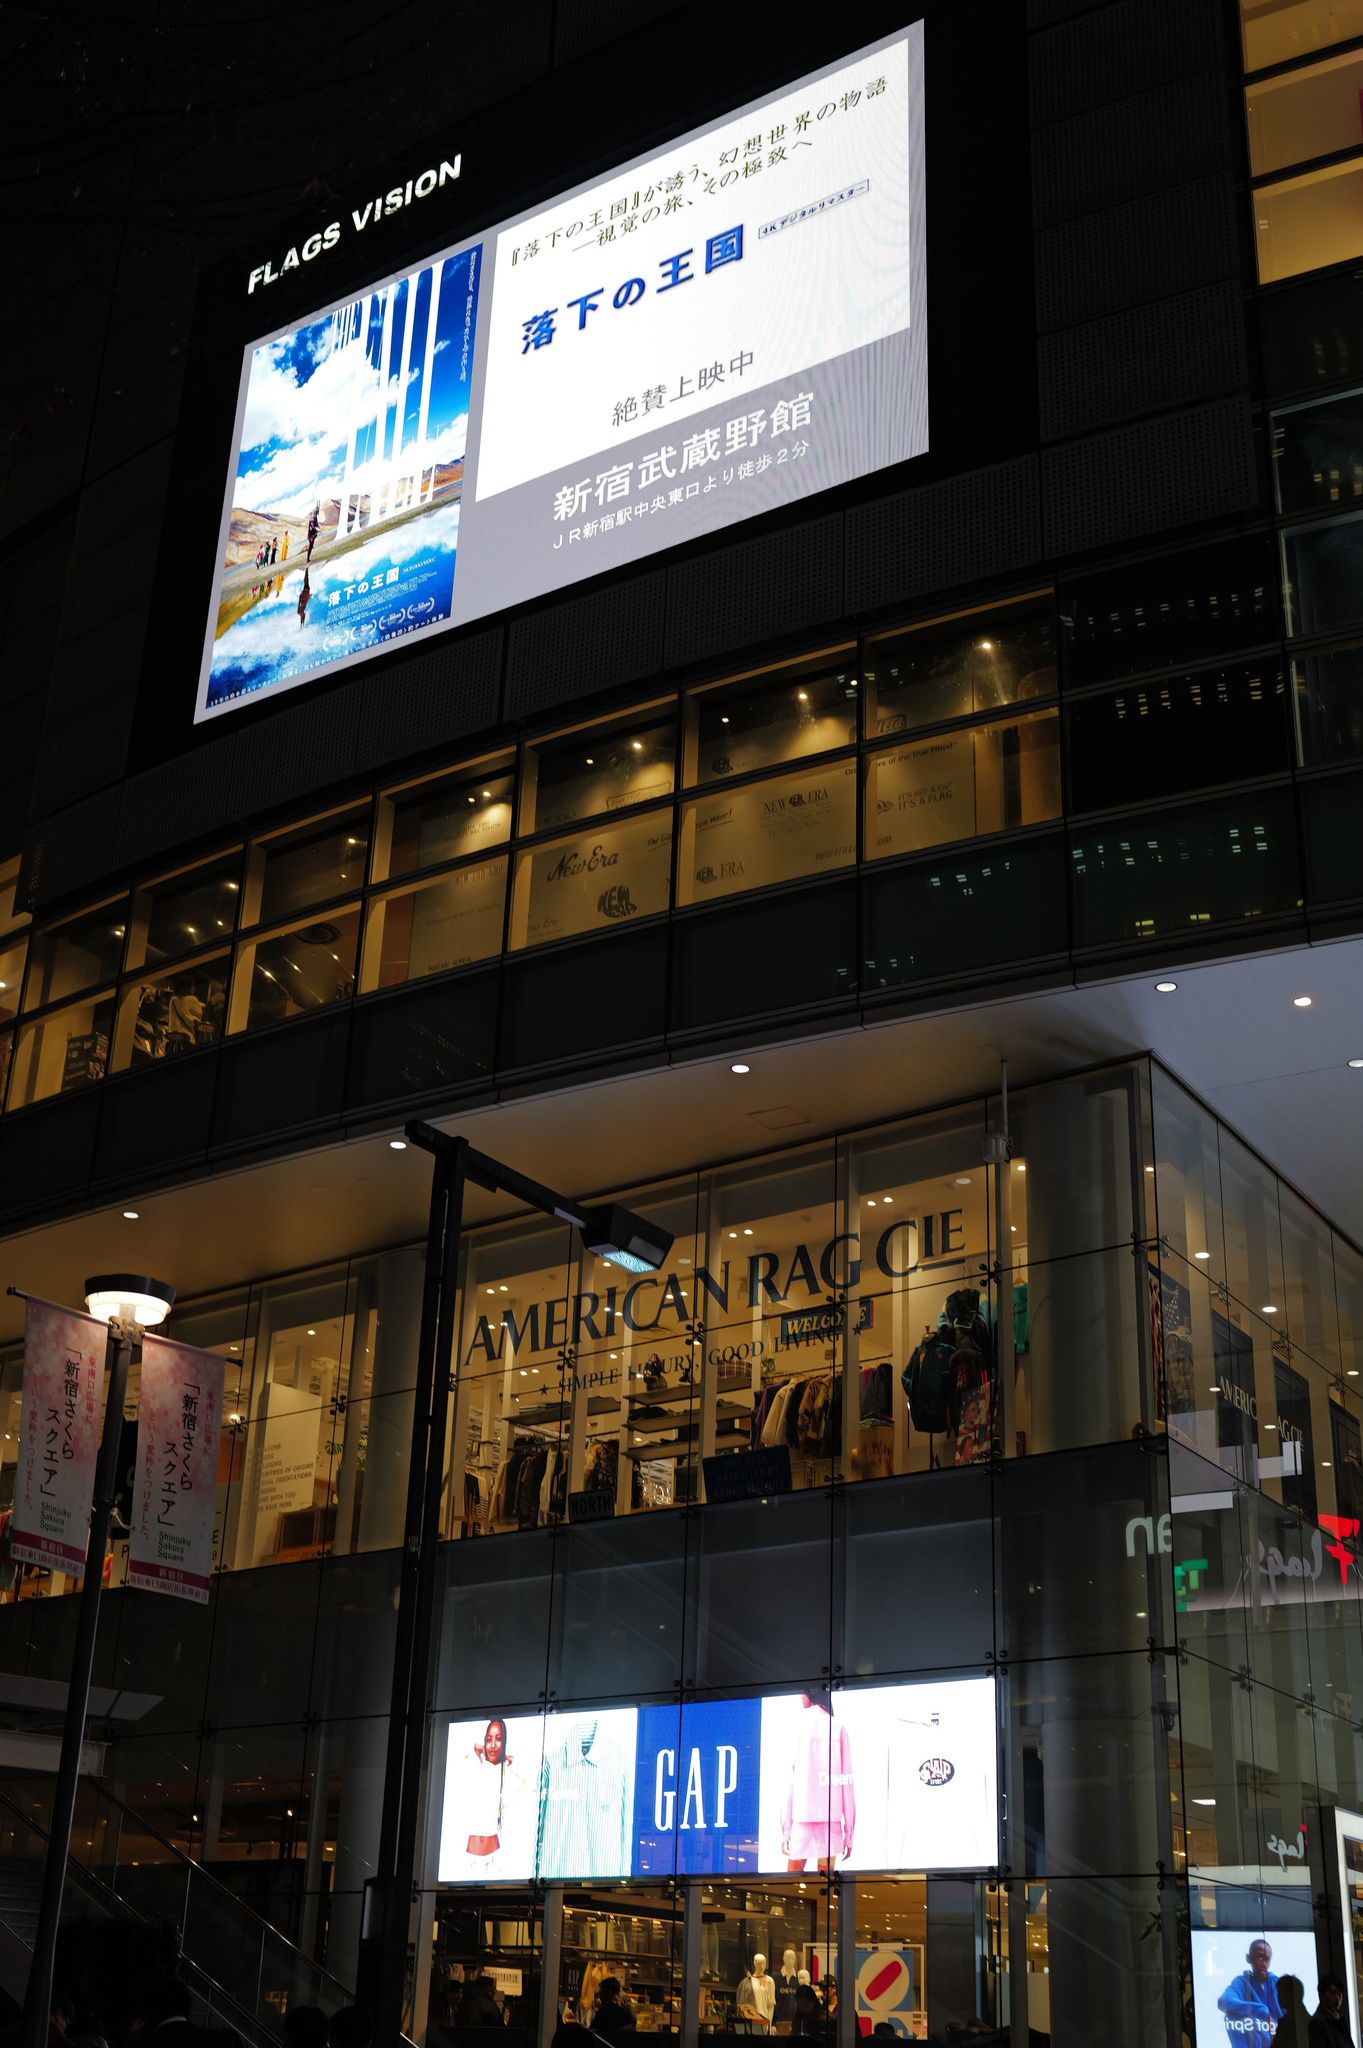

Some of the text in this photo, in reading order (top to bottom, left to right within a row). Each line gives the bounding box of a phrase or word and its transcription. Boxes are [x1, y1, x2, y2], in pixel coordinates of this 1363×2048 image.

[248, 154, 461, 294] FLAGS VISION
[521, 223, 745, 355] 落下の王国
[612, 350, 754, 427] 絶賛上映中
[553, 392, 814, 521] 新宿武蔵野館
[328, 566, 400, 607] 落下の王国
[808, 788, 829, 803] ERA
[547, 845, 620, 882] New Era
[720, 860, 745, 879] ERA
[464, 1209, 966, 1366] AMERICAN RAG CIE
[558, 1368, 619, 1396] SIMPLE
[709, 1340, 764, 1366] GOOD
[775, 1330, 840, 1354] LIVING
[40, 1407, 61, 1497] スクエア」
[157, 1441, 179, 1527] スクエア」
[40, 1510, 65, 1526] Sakura
[41, 1501, 72, 1519] Shinjuku
[571, 1495, 611, 1515] NORTH
[39, 1520, 65, 1536] Square
[158, 1531, 192, 1547] Shinjuku
[158, 1540, 185, 1554] Sakura
[157, 1549, 184, 1563] Square
[654, 1745, 738, 1831] GAP
